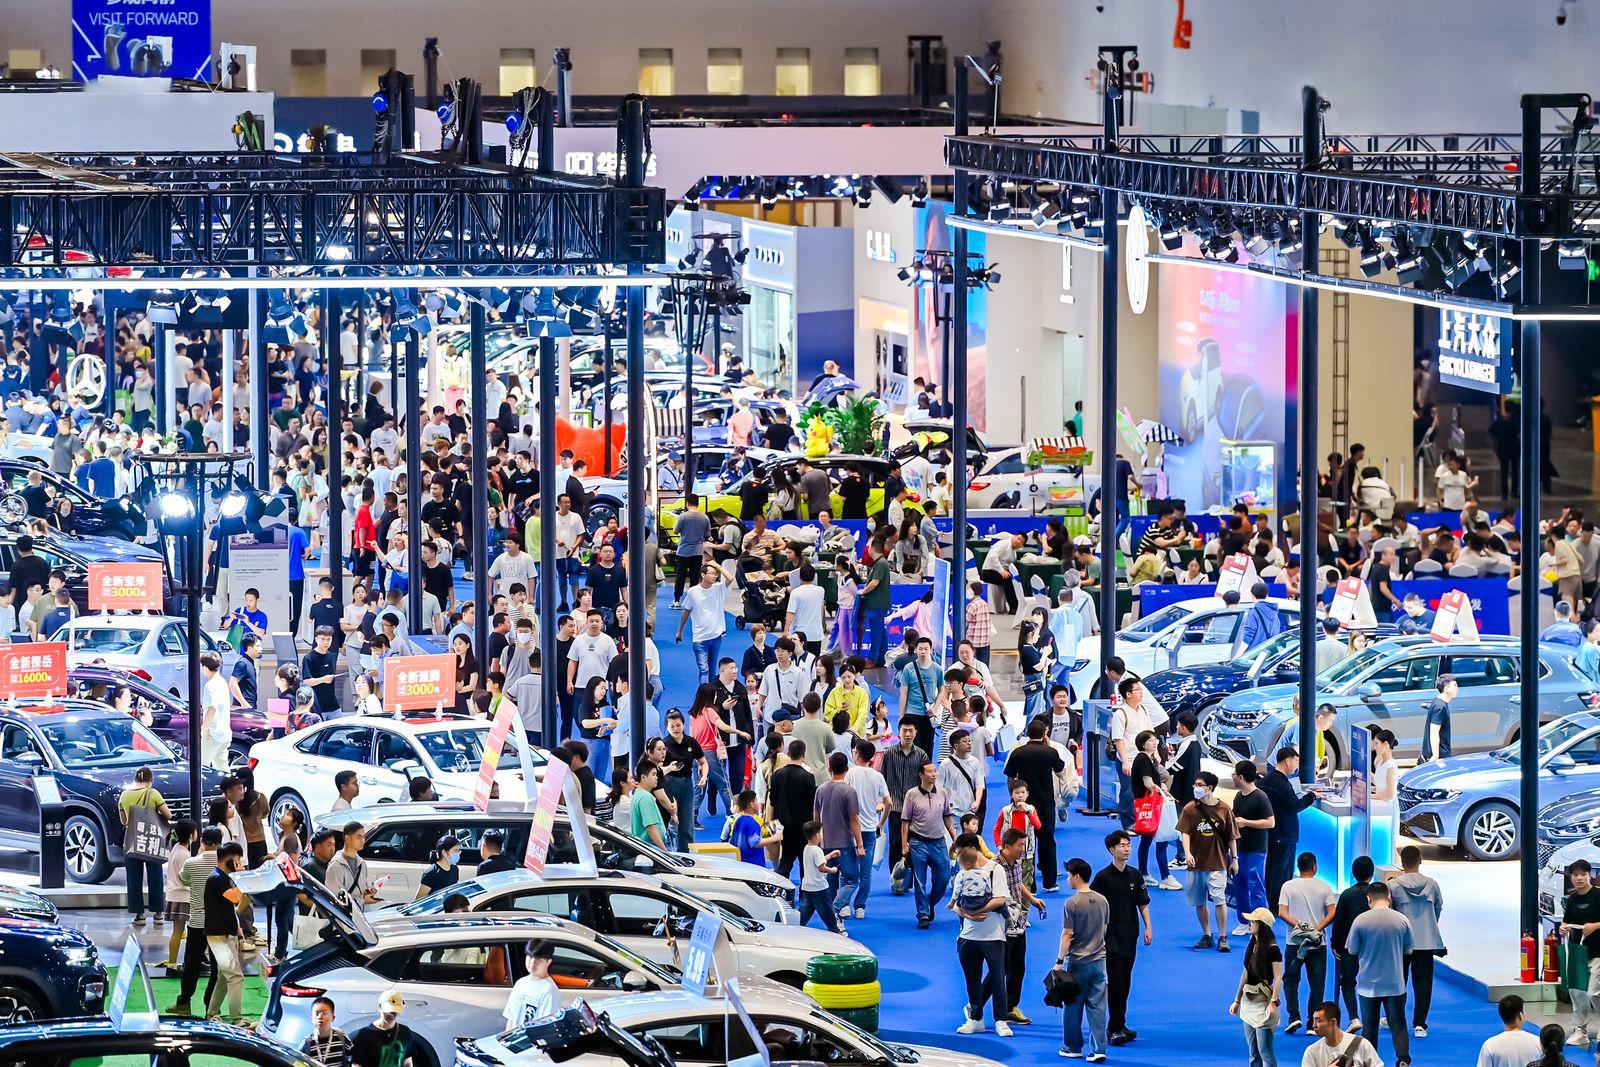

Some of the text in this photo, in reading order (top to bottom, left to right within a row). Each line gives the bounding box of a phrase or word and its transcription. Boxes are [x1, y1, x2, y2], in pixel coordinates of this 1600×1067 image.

[88, 12, 199, 25] VISIT FORWARD
[136, 834, 161, 856] 吉利
